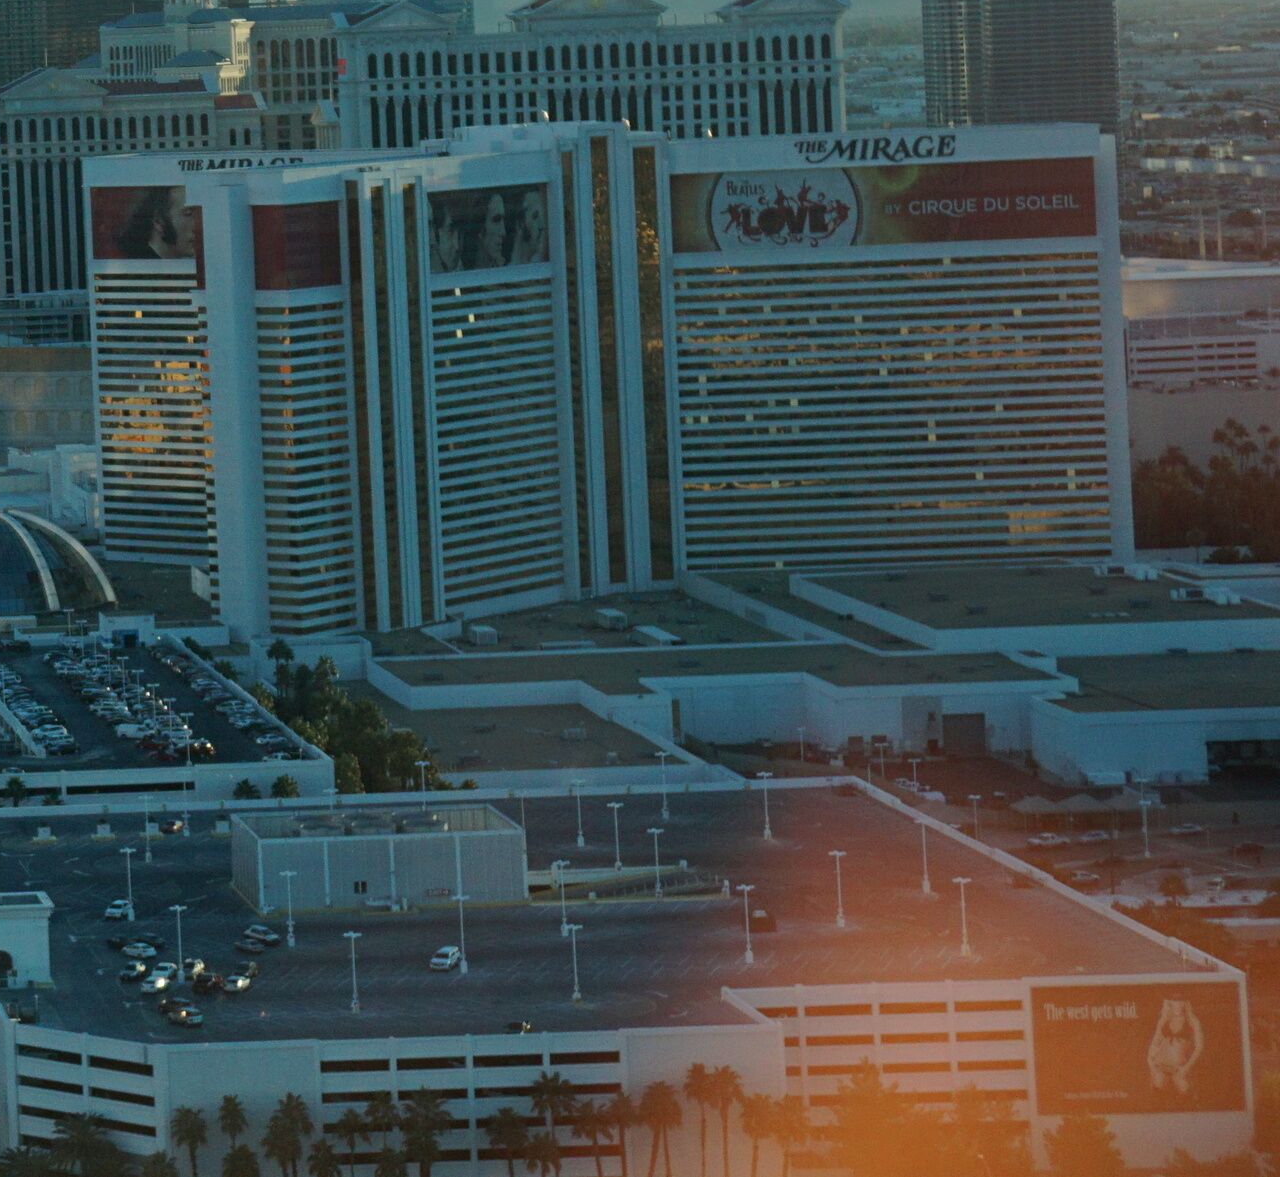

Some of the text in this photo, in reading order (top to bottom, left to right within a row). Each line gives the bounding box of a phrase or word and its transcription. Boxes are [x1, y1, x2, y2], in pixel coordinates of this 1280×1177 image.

[794, 134, 957, 164] THE MIRAGE
[178, 159, 204, 172] THE
[909, 199, 978, 218] CIRQUE
[984, 197, 1009, 213] DU
[1016, 194, 1080, 211] SOLEIL
[1043, 1002, 1064, 1021] The
